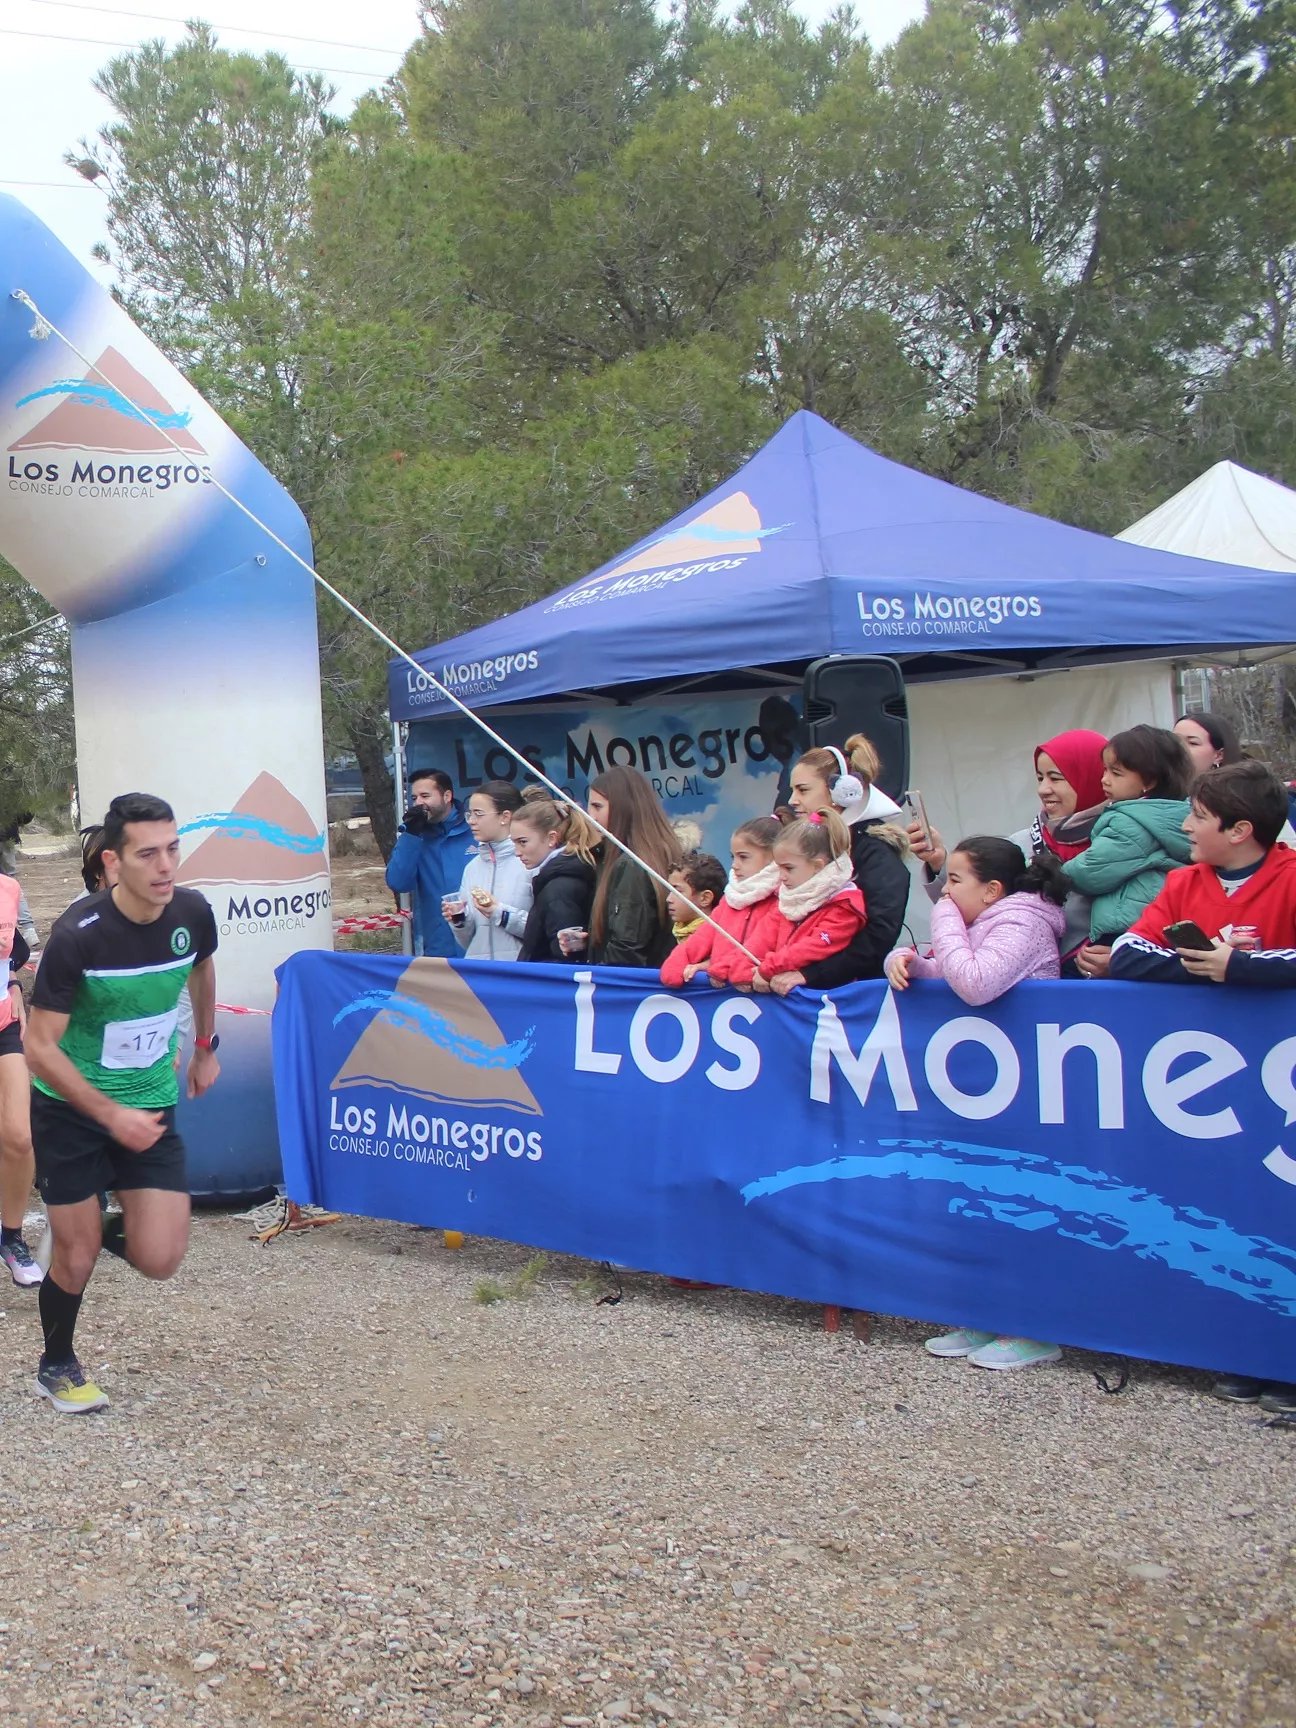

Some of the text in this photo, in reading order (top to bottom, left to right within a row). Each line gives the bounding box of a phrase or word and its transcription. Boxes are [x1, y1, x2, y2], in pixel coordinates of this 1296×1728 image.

[8, 456, 213, 490] Los Monegros
[8, 480, 155, 499] CONSEJO COMARCAL
[554, 557, 748, 606] Los Monegros
[599, 582, 669, 602] COMARCAL
[857, 592, 1042, 625] Los Monegros
[862, 620, 991, 637] CONSEJO COMARCAL
[407, 650, 538, 693] Los Monegros
[455, 725, 772, 788] Los Monegro
[237, 917, 306, 935] COMARCAL
[132, 1030, 159, 1051] 17
[574, 971, 763, 1091] Los
[329, 1096, 543, 1163] Los Monegros
[328, 1134, 471, 1172] CONSEJO COMARCAL
